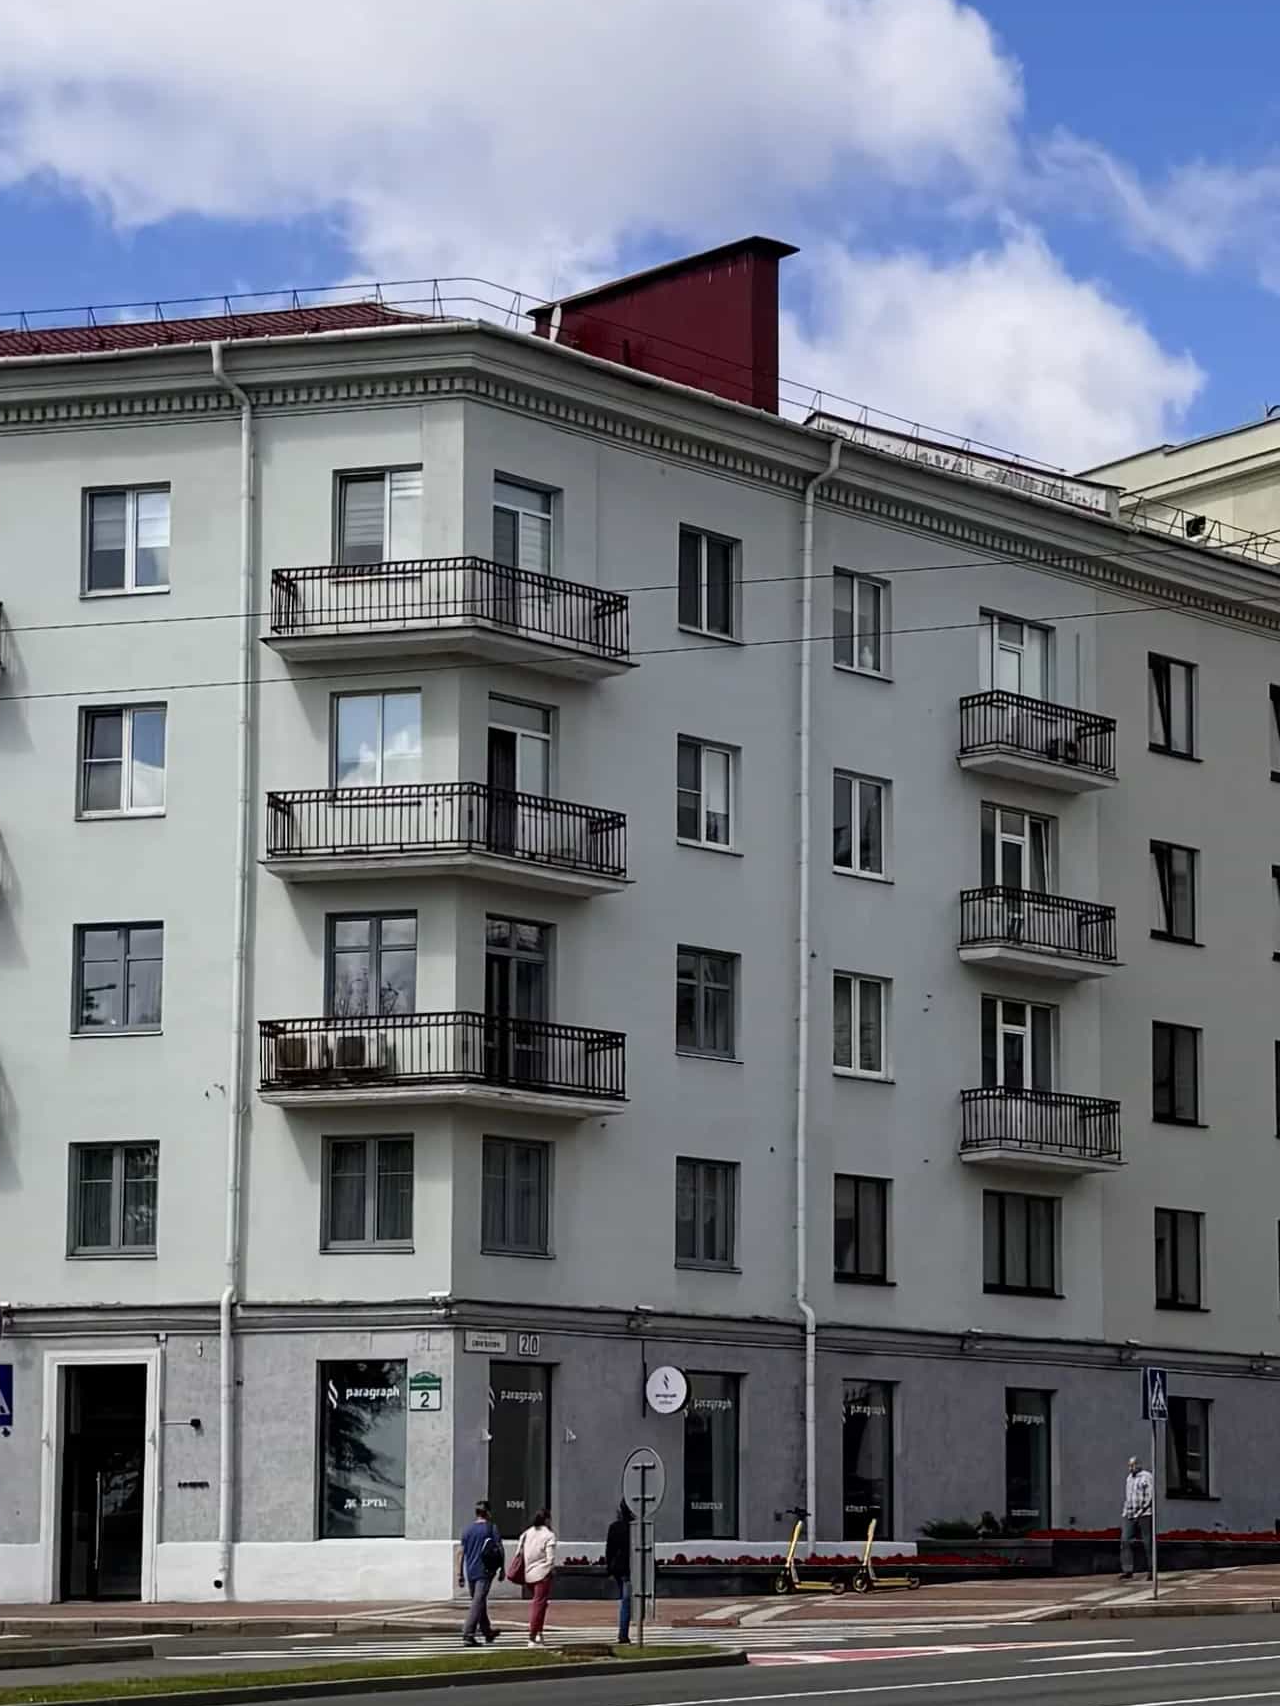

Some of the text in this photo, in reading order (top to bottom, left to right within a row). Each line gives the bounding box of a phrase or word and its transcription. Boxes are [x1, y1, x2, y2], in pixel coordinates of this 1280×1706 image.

[521, 1336, 538, 1353] 20
[346, 1385, 400, 1400] paragraph
[420, 1391, 430, 1408] 2
